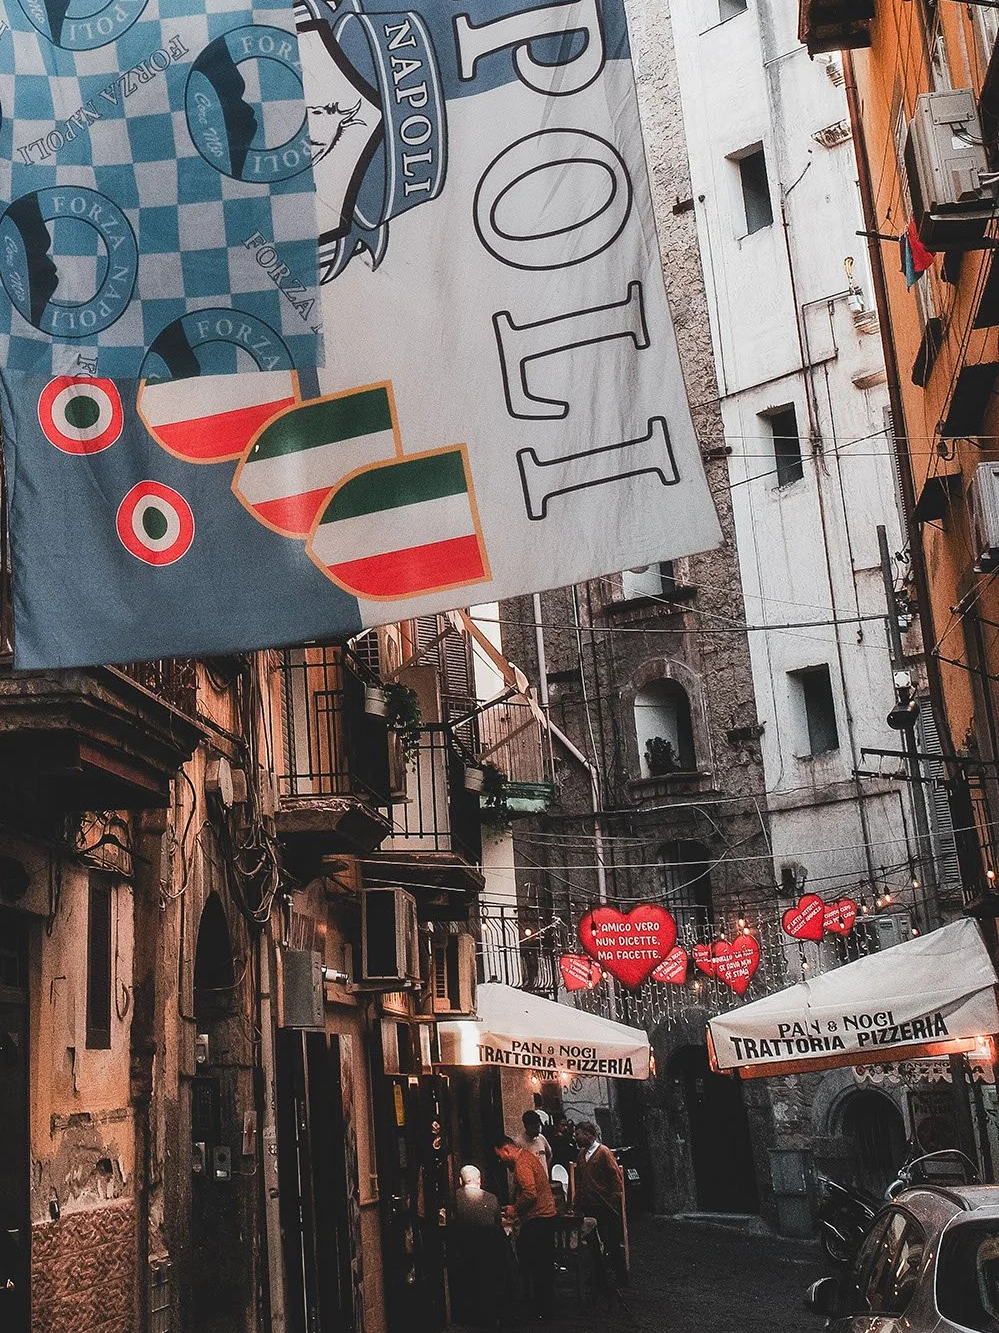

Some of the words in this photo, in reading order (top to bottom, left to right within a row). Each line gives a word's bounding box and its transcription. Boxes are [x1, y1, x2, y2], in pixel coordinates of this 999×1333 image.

[99, 34, 190, 107] FORZA
[240, 35, 299, 66] FOR
[381, 18, 439, 196] NAPOLI
[16, 98, 103, 167] NAPOLI
[252, 135, 311, 174] POLI
[52, 196, 126, 251] FORZA
[51, 266, 128, 329] NAPOLI
[242, 231, 316, 321] FORZA
[196, 318, 281, 371] FORZA
[594, 922, 631, 933] 'AMICO
[634, 921, 660, 932] VERO
[595, 937, 616, 947] NUN
[597, 950, 614, 961] MA
[511, 1040, 543, 1054] PAN
[730, 1036, 846, 1061] TRATTORIA
[857, 1012, 950, 1047] PIZZERIA
[777, 1020, 822, 1040] PAN
[476, 1044, 557, 1069] TRATTORIA
[567, 1057, 634, 1076] PIZZERIA
